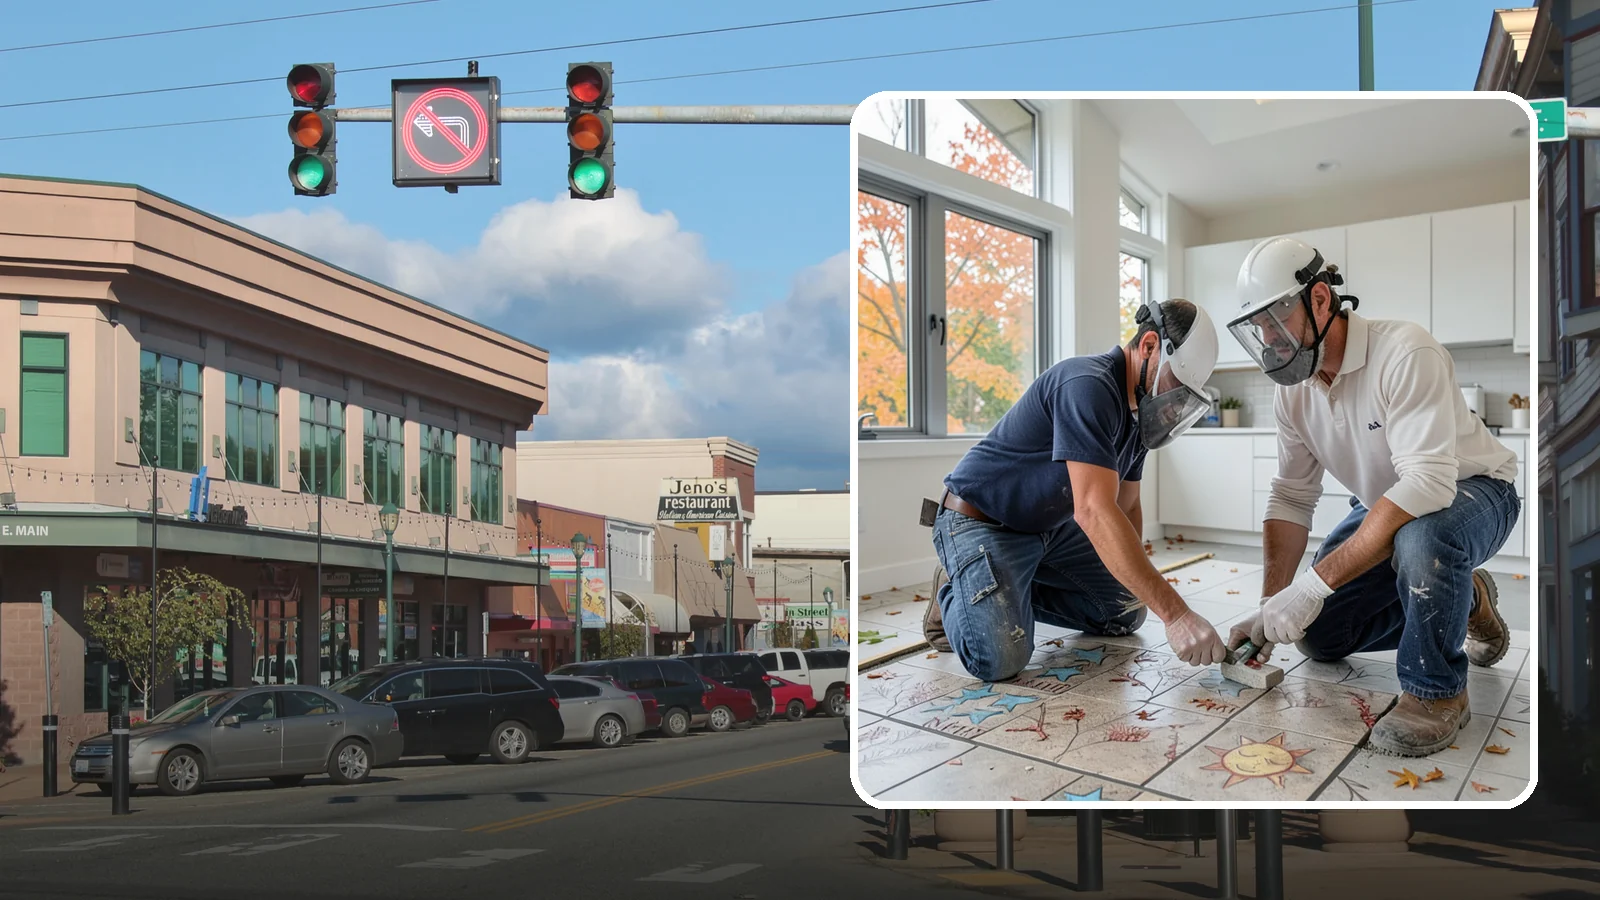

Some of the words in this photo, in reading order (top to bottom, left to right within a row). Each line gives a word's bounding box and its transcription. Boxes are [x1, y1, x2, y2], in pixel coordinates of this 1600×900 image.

[670, 480, 728, 494] Jeno's
[665, 496, 731, 509] restaurant
[659, 510, 681, 519] Italian
[686, 510, 714, 519] American
[715, 510, 737, 519] Cuisine
[2, 525, 13, 536] E.
[15, 525, 49, 536] MAIN
[797, 607, 828, 616] Street
